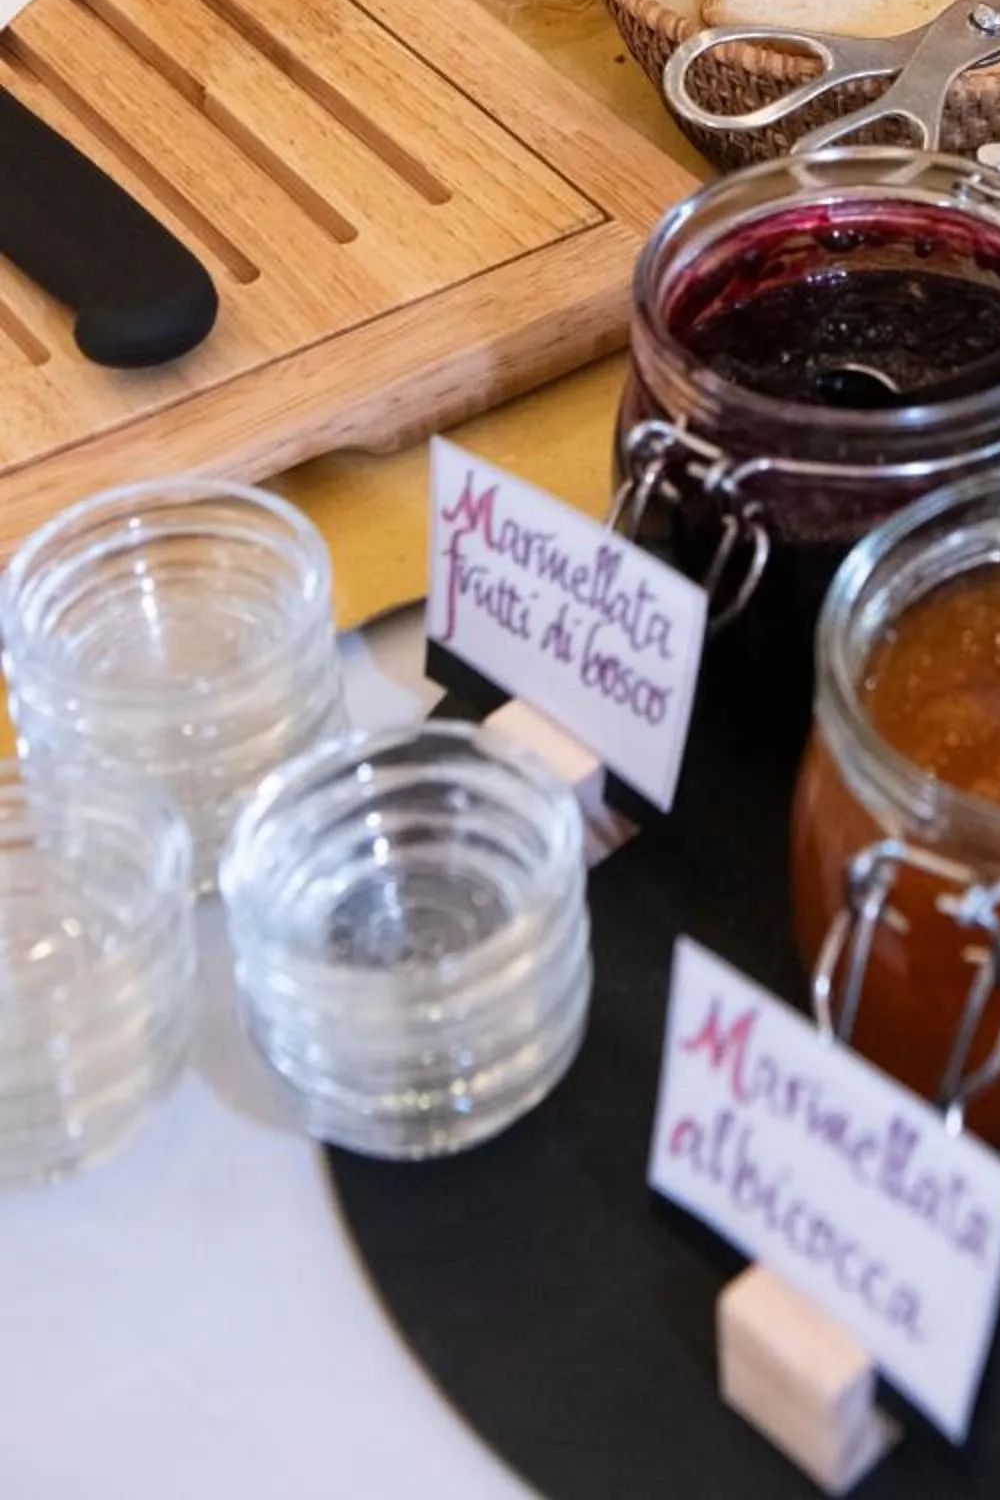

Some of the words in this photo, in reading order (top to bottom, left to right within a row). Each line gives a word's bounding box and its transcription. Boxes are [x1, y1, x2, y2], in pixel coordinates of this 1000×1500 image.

[441, 468, 674, 659] Marmellata
[442, 528, 540, 642] frutti
[580, 620, 674, 726] bosco
[669, 1108, 929, 1342] albicocca
